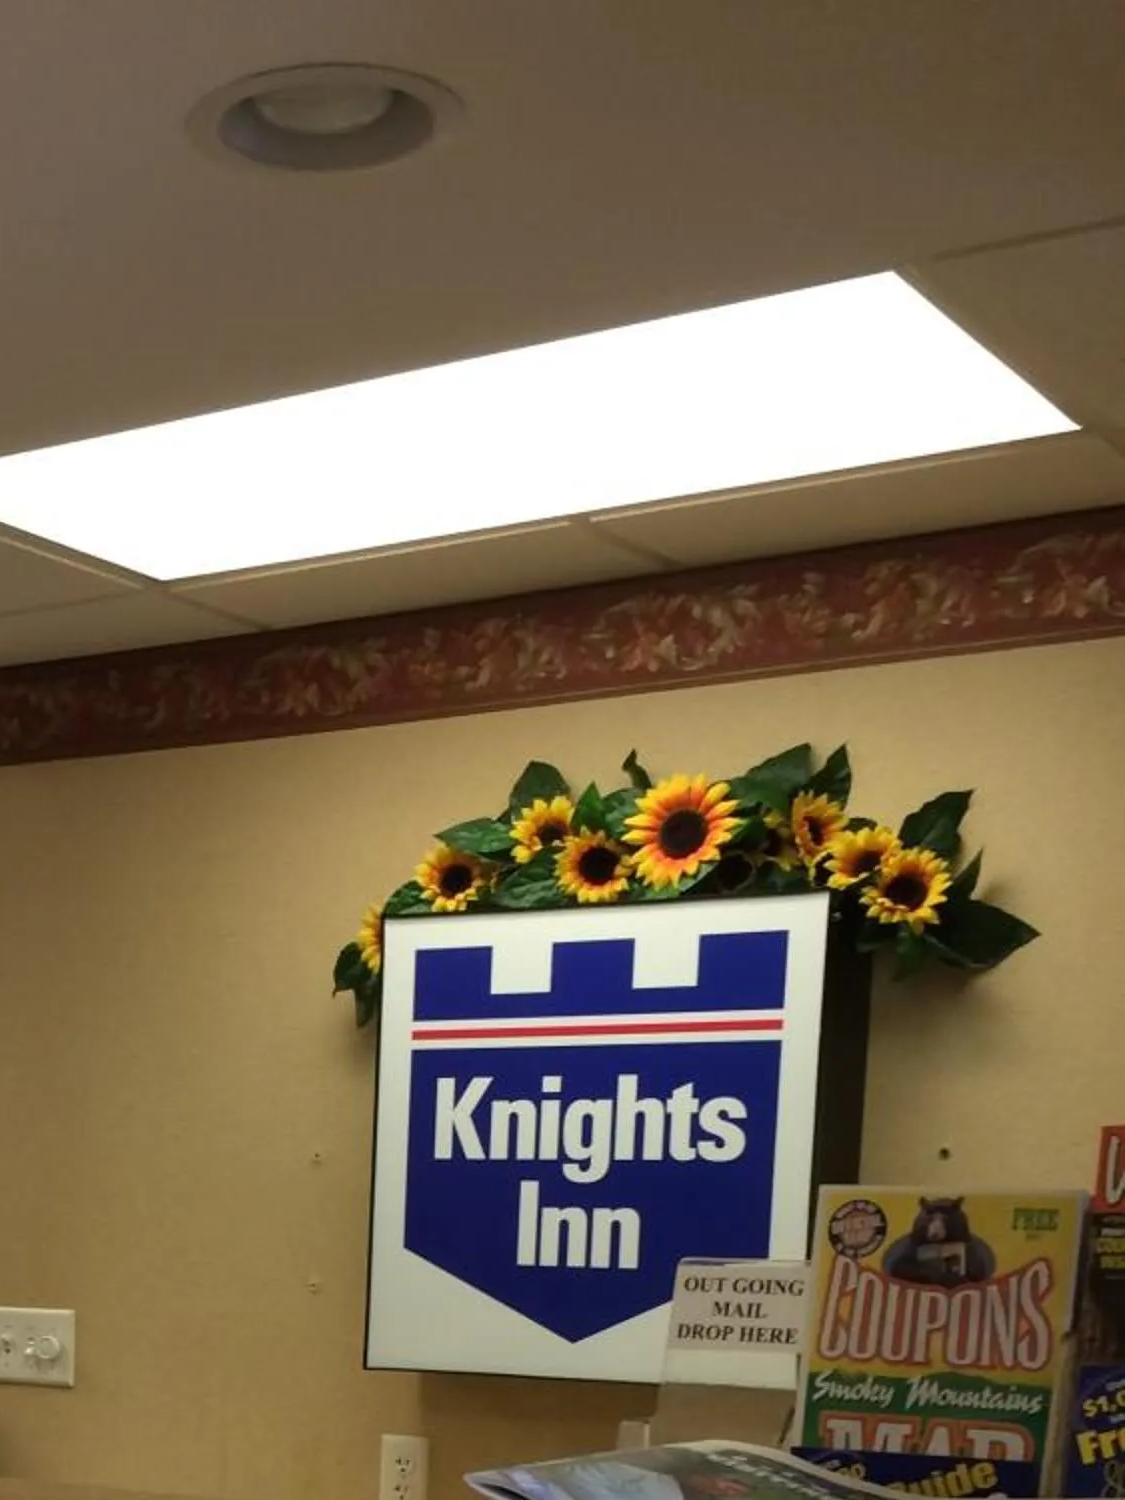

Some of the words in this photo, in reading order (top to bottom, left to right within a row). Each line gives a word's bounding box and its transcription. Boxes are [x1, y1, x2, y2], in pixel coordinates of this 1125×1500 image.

[433, 1073, 747, 1183] Knights
[516, 1180, 641, 1269] Inn
[1012, 1207, 1060, 1231] FREE
[684, 1276, 727, 1293] OUT
[732, 1278, 805, 1296] GOING
[713, 1301, 769, 1319] MAIL
[820, 1254, 1050, 1369] COUPONS
[677, 1323, 734, 1341] DROP
[739, 1326, 798, 1344] HERE
[812, 1369, 896, 1408] Smoky
[905, 1375, 1043, 1415] Mountains
